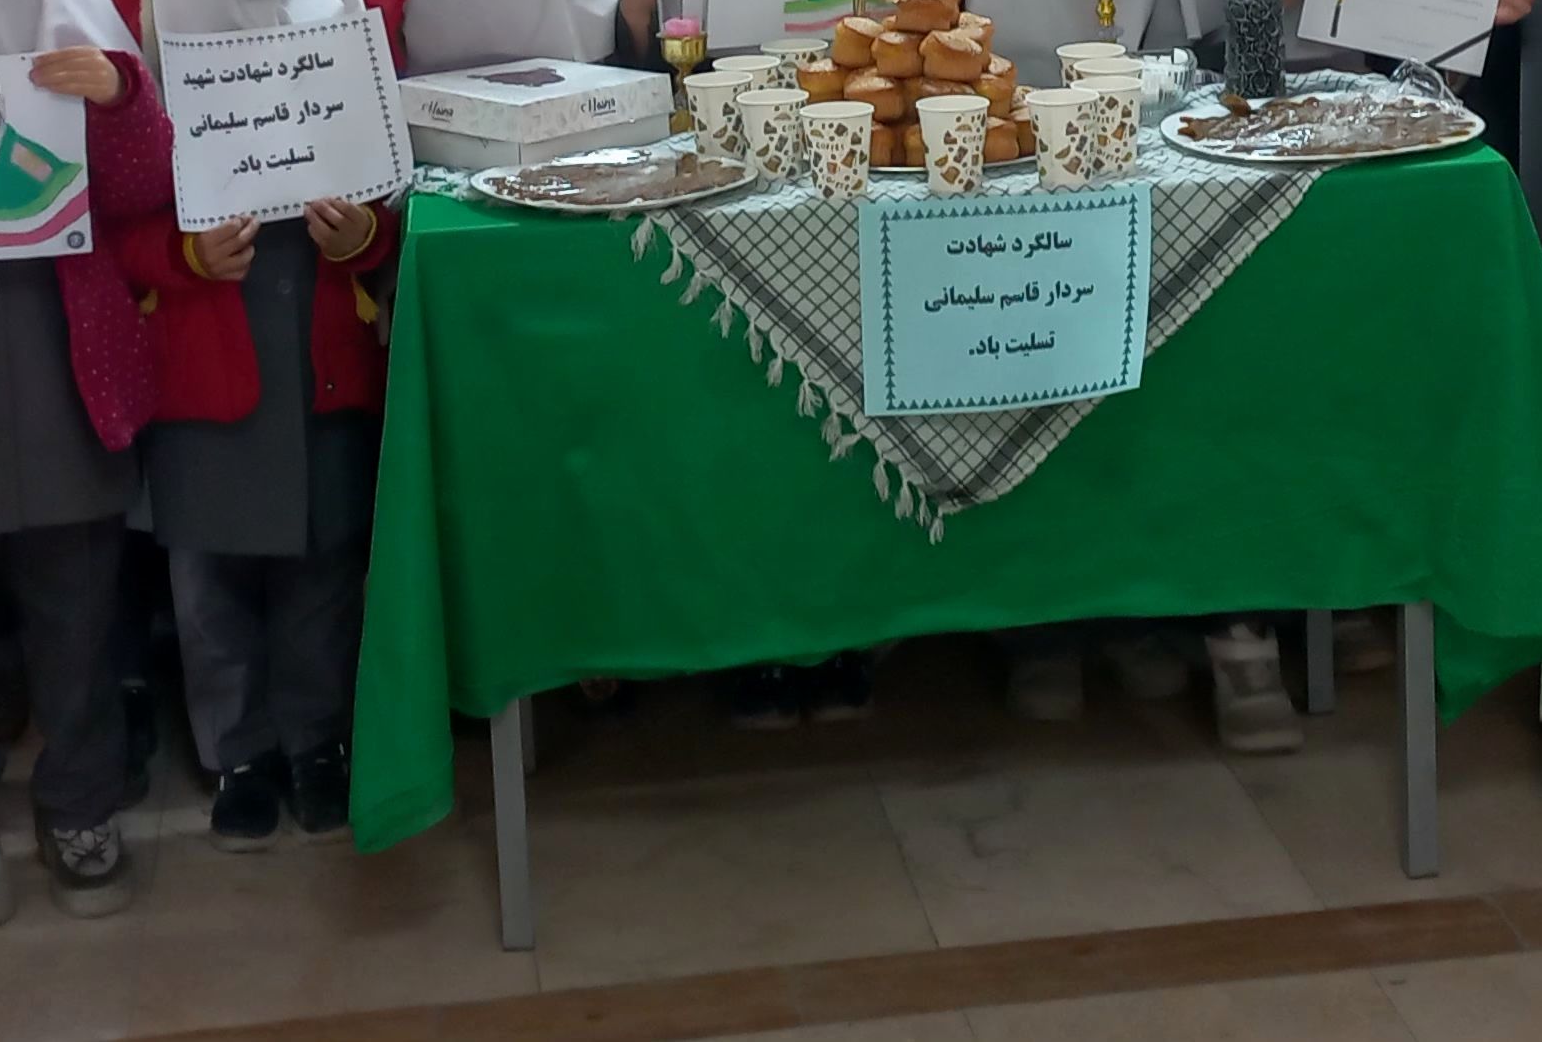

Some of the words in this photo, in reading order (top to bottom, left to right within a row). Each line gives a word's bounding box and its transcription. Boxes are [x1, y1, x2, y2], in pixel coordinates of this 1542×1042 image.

[183, 67, 215, 90] شهید
[219, 61, 273, 84] شهادت
[277, 52, 335, 80] سالگرد
[189, 111, 249, 138] سلیمانی
[253, 103, 290, 131] قاسم
[296, 100, 345, 125] سردار
[232, 156, 263, 175] باد.
[266, 145, 316, 172] تسلیت
[946, 233, 1007, 257] شهادت
[1011, 231, 1073, 258] سالگرد
[924, 285, 995, 312] سلیمانی
[1000, 281, 1040, 310] قاسم
[1045, 281, 1095, 307] سردار
[969, 335, 1001, 359] باد.
[1005, 330, 1055, 357] تسلیت
